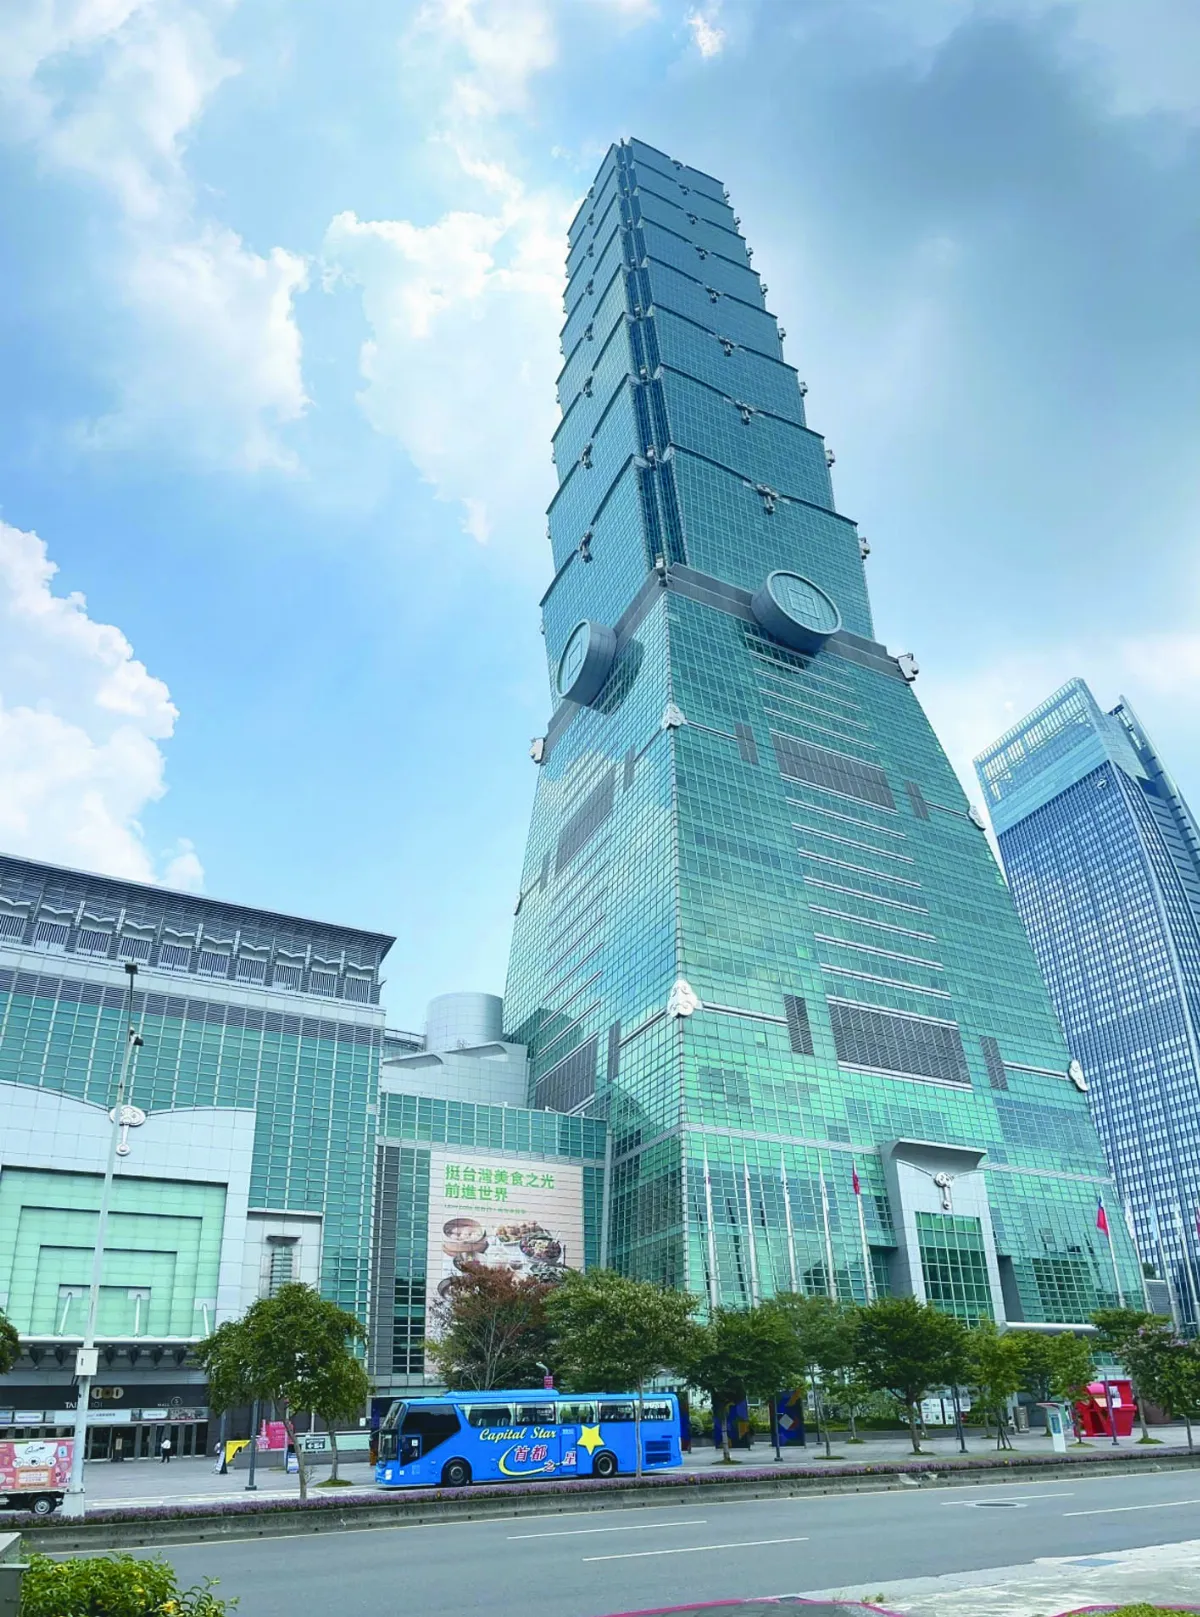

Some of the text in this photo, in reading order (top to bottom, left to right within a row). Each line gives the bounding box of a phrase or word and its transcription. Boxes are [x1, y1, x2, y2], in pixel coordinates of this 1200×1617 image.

[445, 1164, 555, 1189] 挺台灣美食之光
[445, 1183, 508, 1202] 前進世界
[479, 1427, 527, 1443] Capital
[530, 1426, 557, 1439] Star
